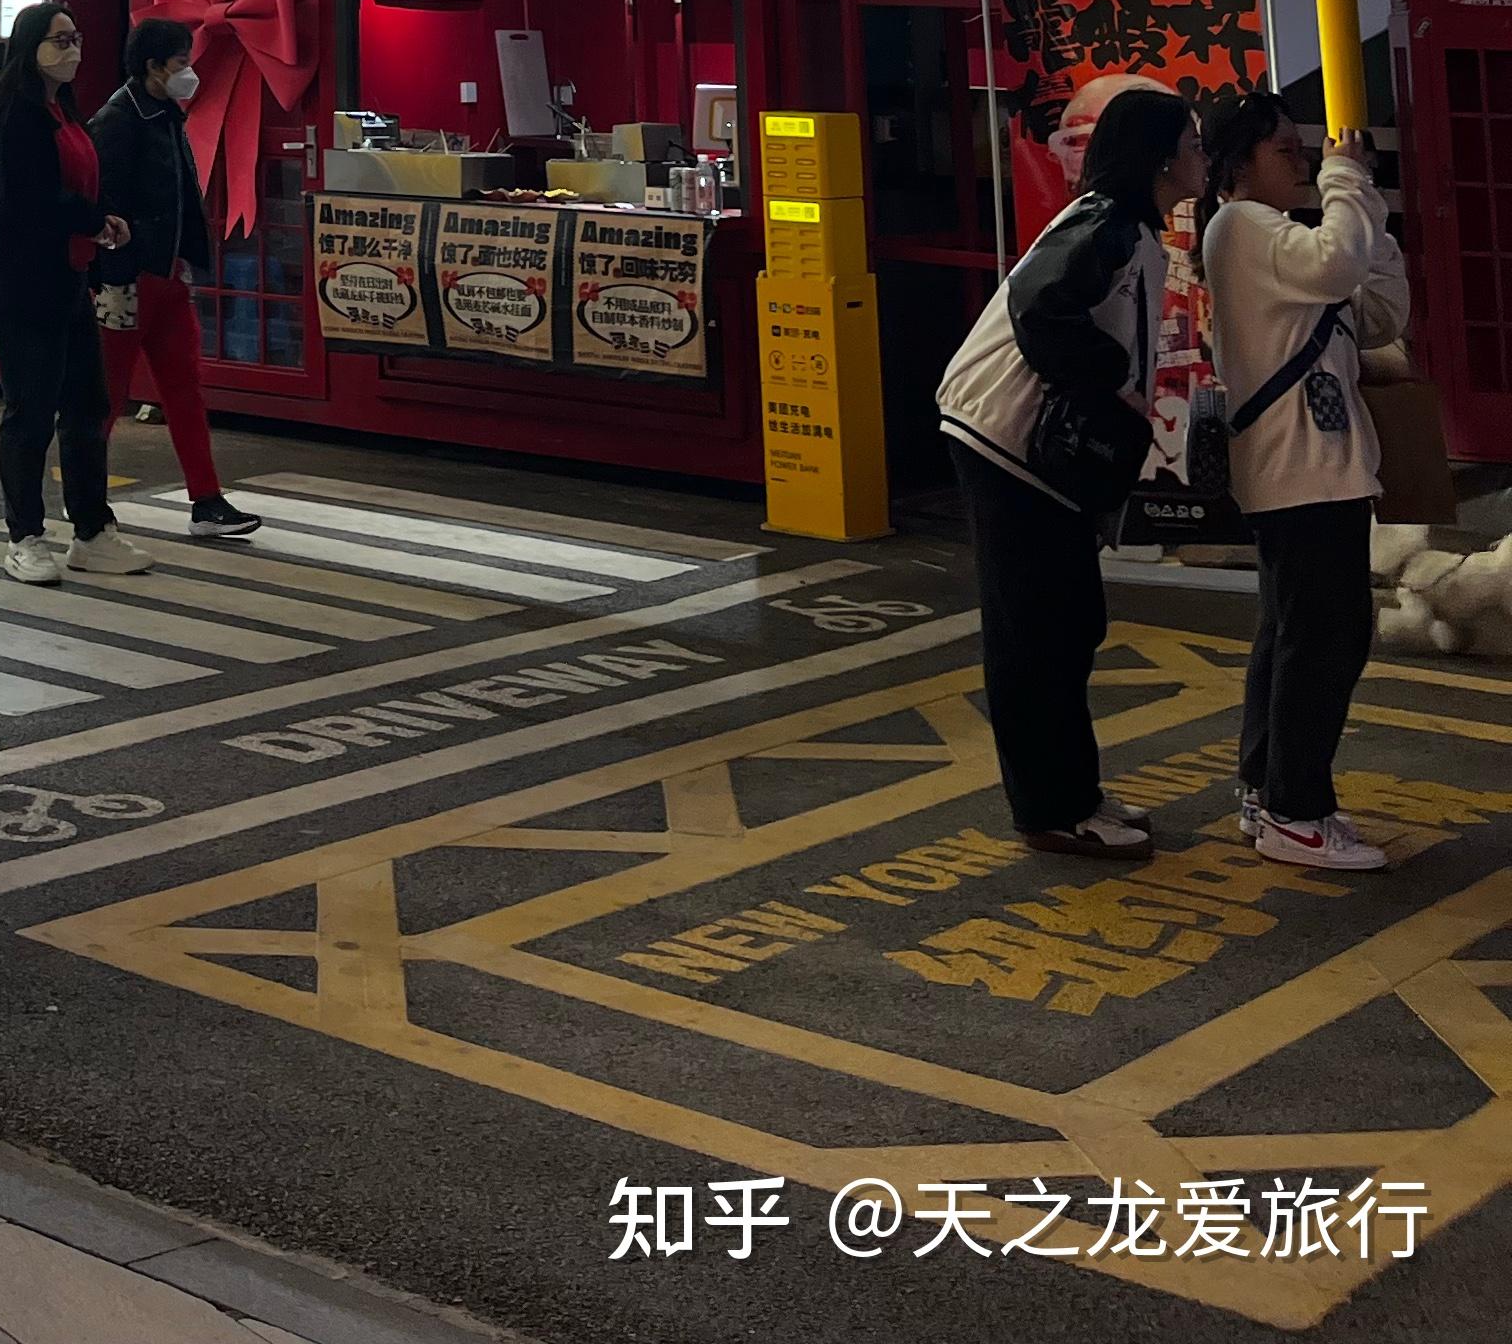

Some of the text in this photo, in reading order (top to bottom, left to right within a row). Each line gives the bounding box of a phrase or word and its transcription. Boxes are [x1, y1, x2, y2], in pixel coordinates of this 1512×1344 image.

[319, 203, 417, 236] Amazing
[443, 211, 551, 245] Amazing
[580, 220, 698, 257] Amazing
[220, 638, 726, 764] DRIVEWAY
[615, 900, 850, 985] NEW
[803, 826, 1031, 908] YORK
